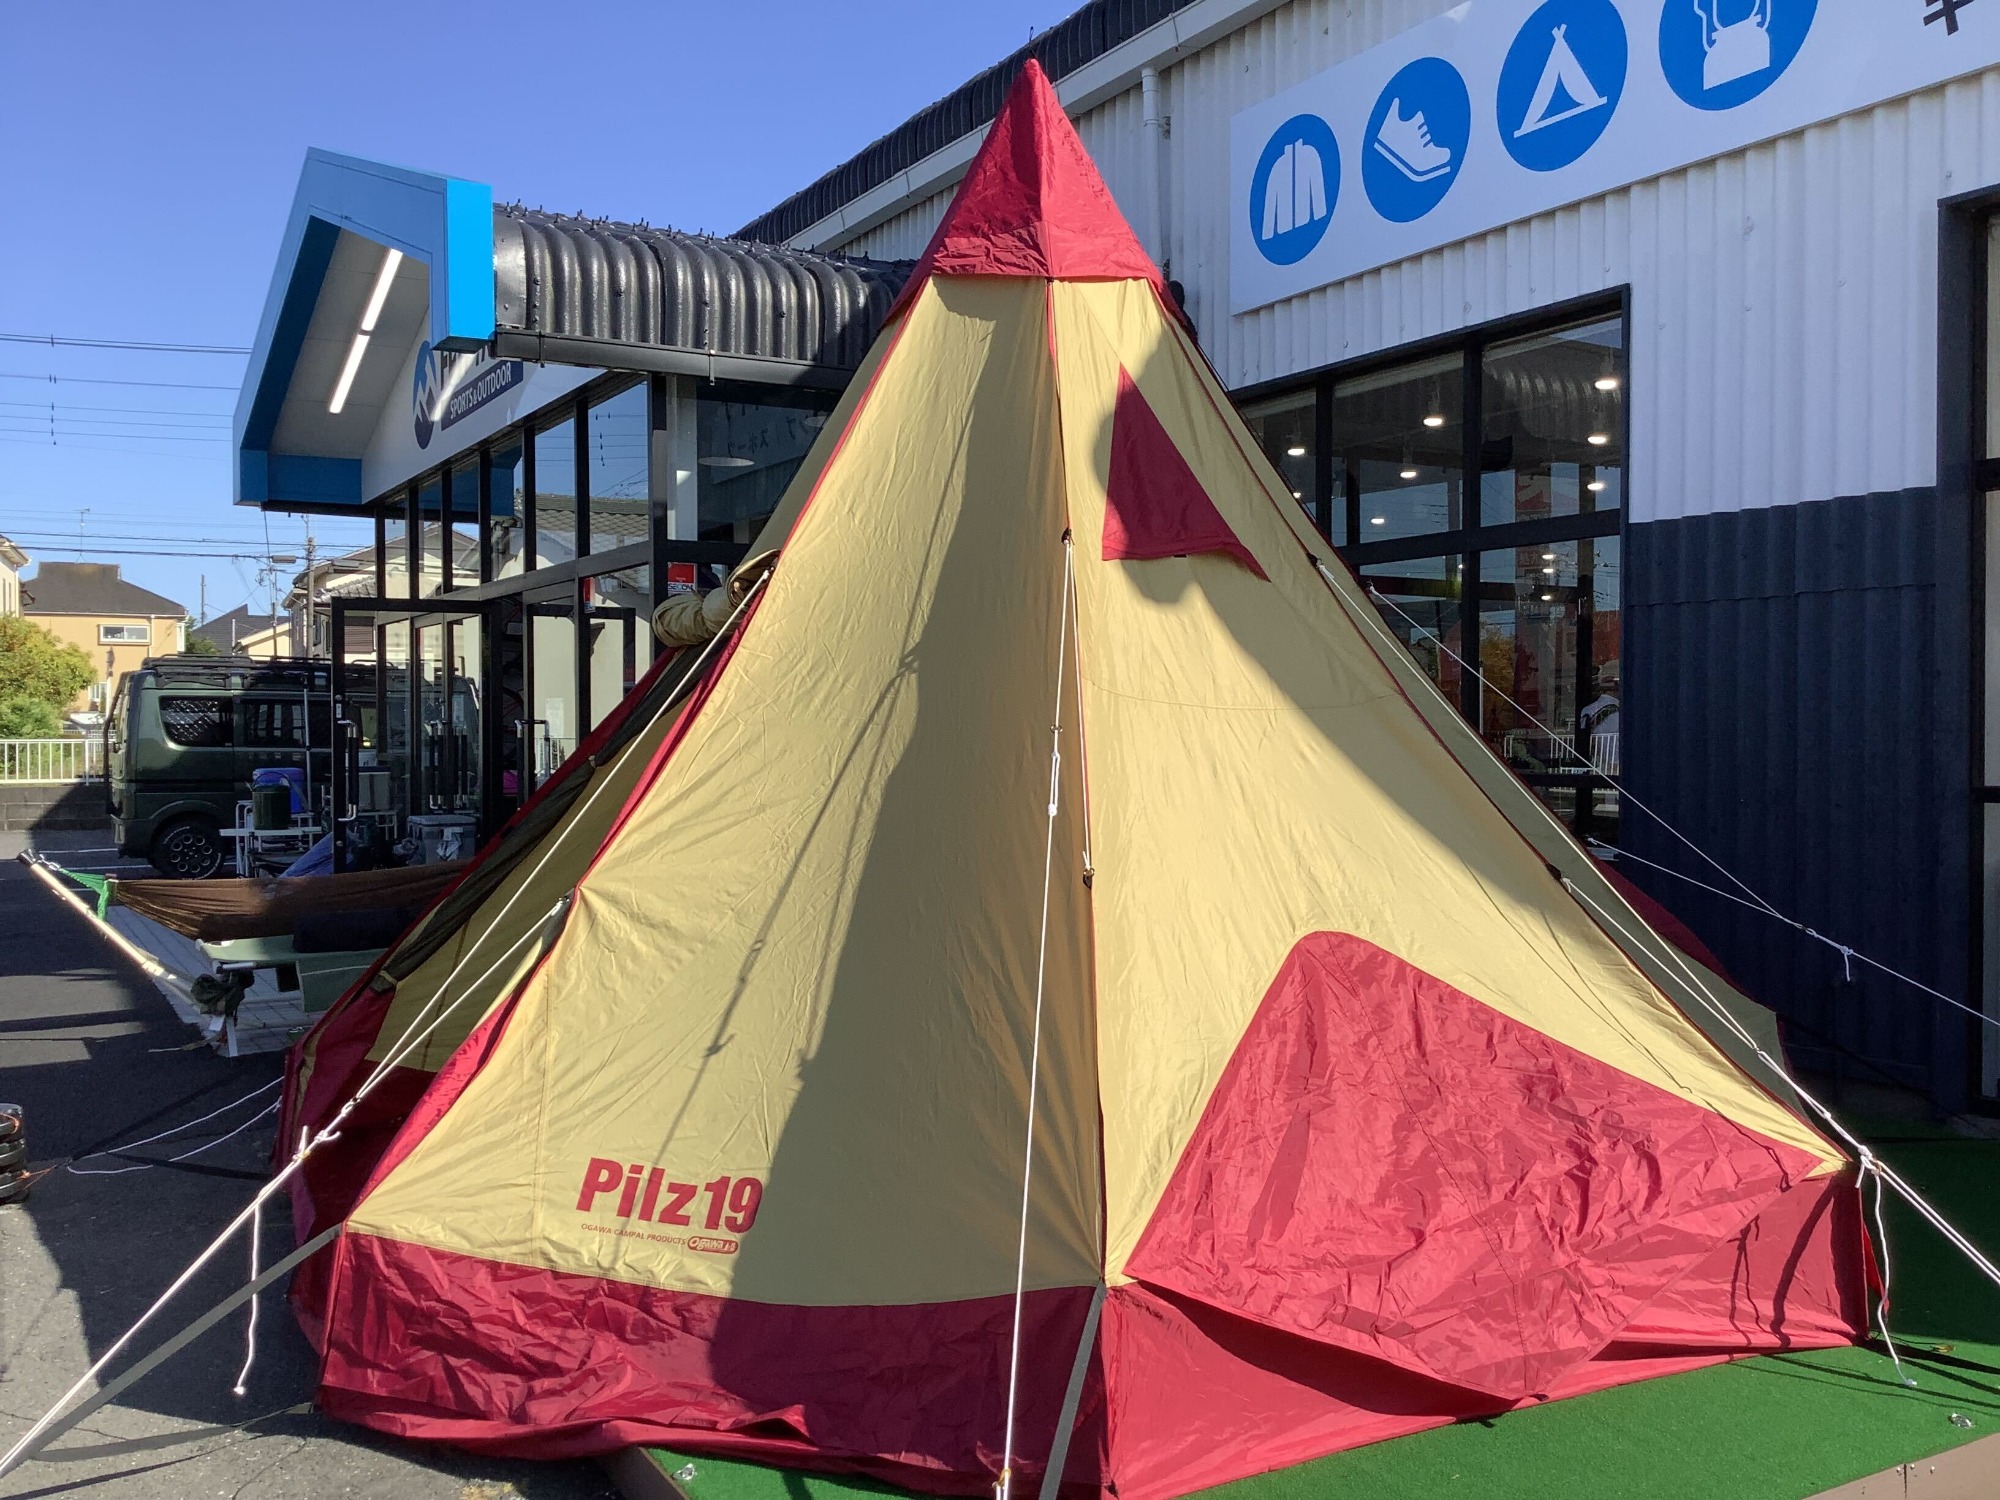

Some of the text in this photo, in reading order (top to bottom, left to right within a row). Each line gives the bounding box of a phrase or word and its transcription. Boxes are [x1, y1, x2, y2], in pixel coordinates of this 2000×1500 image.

[581, 1223, 612, 1235] OGAWA
[613, 1228, 646, 1240] CAMPAL
[646, 1233, 687, 1246] PRODUCTS
